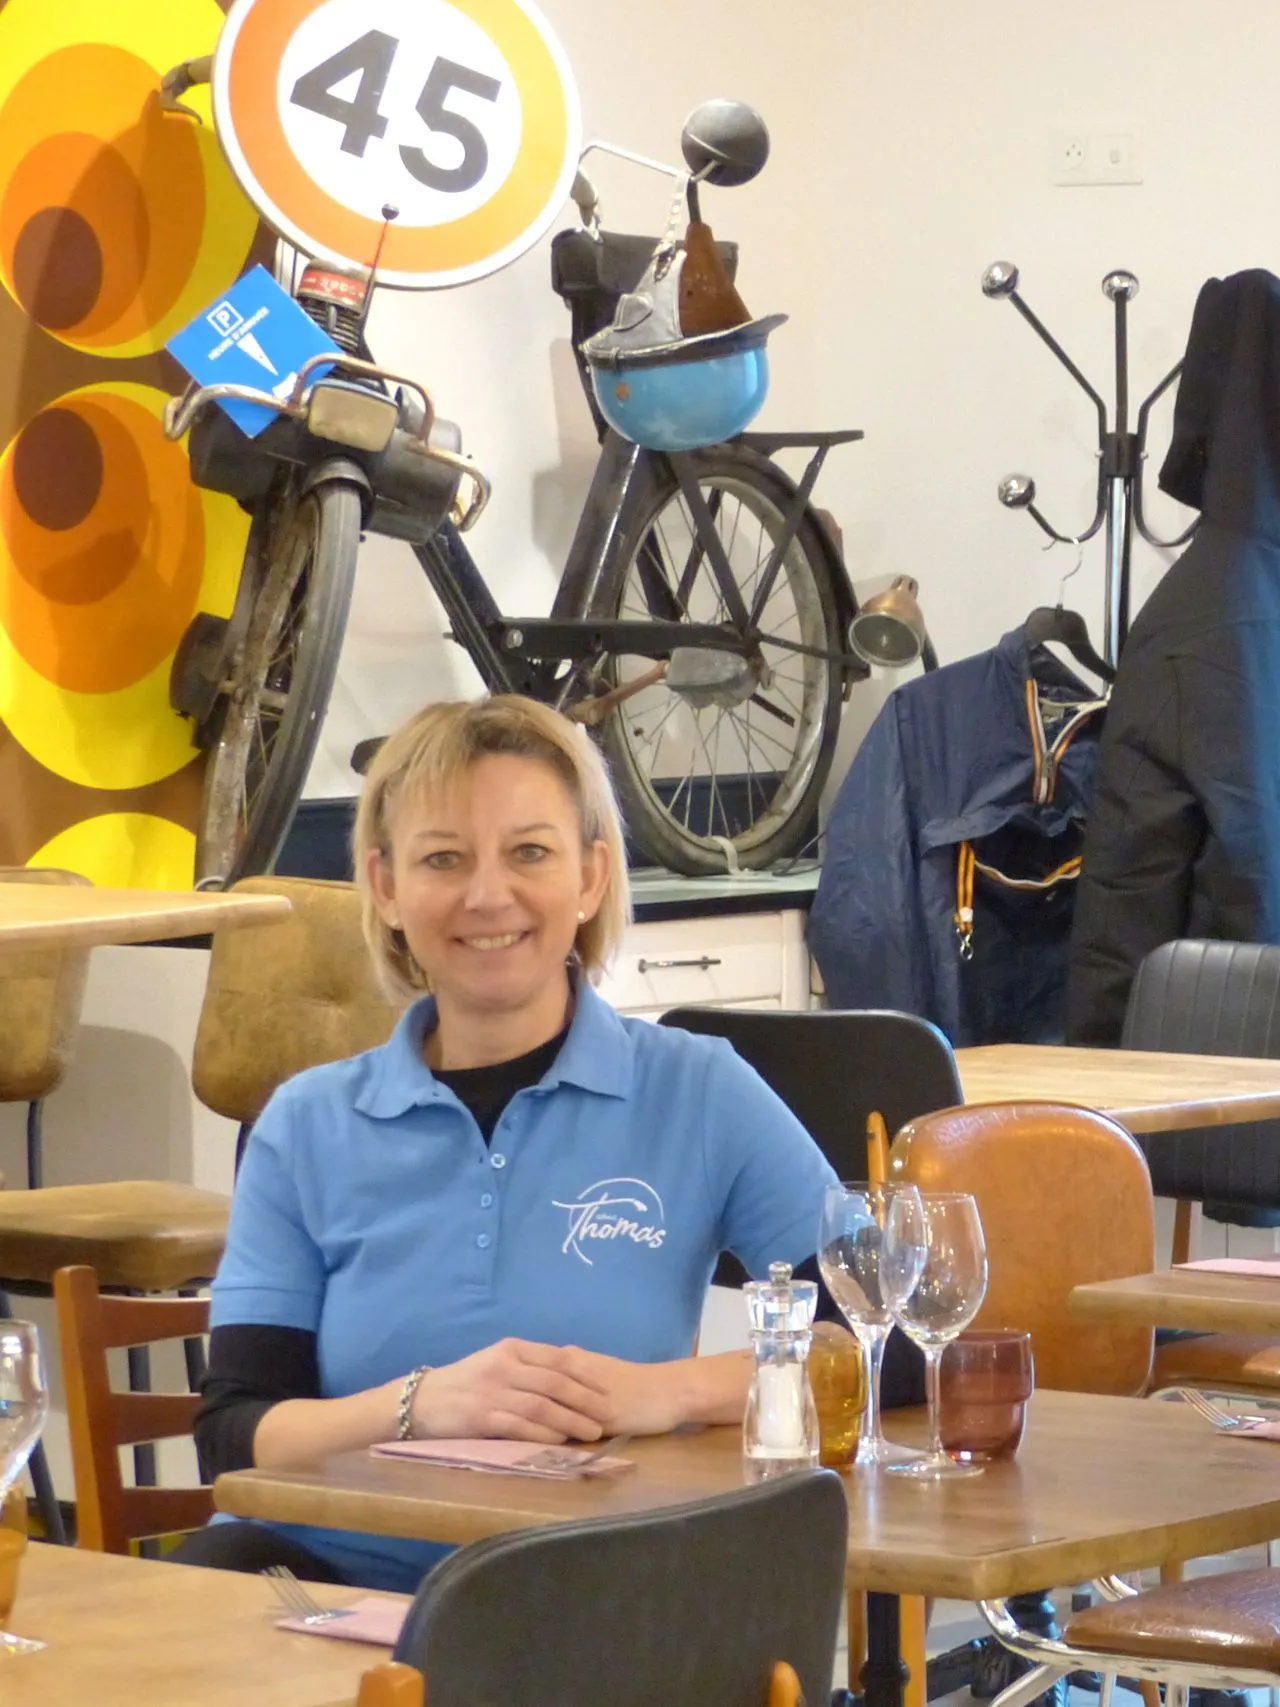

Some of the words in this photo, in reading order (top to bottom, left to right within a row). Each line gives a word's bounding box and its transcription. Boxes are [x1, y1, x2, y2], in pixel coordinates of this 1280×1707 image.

[289, 29, 502, 193] 45
[215, 310, 231, 329] P
[551, 1191, 667, 1254] Thomas
